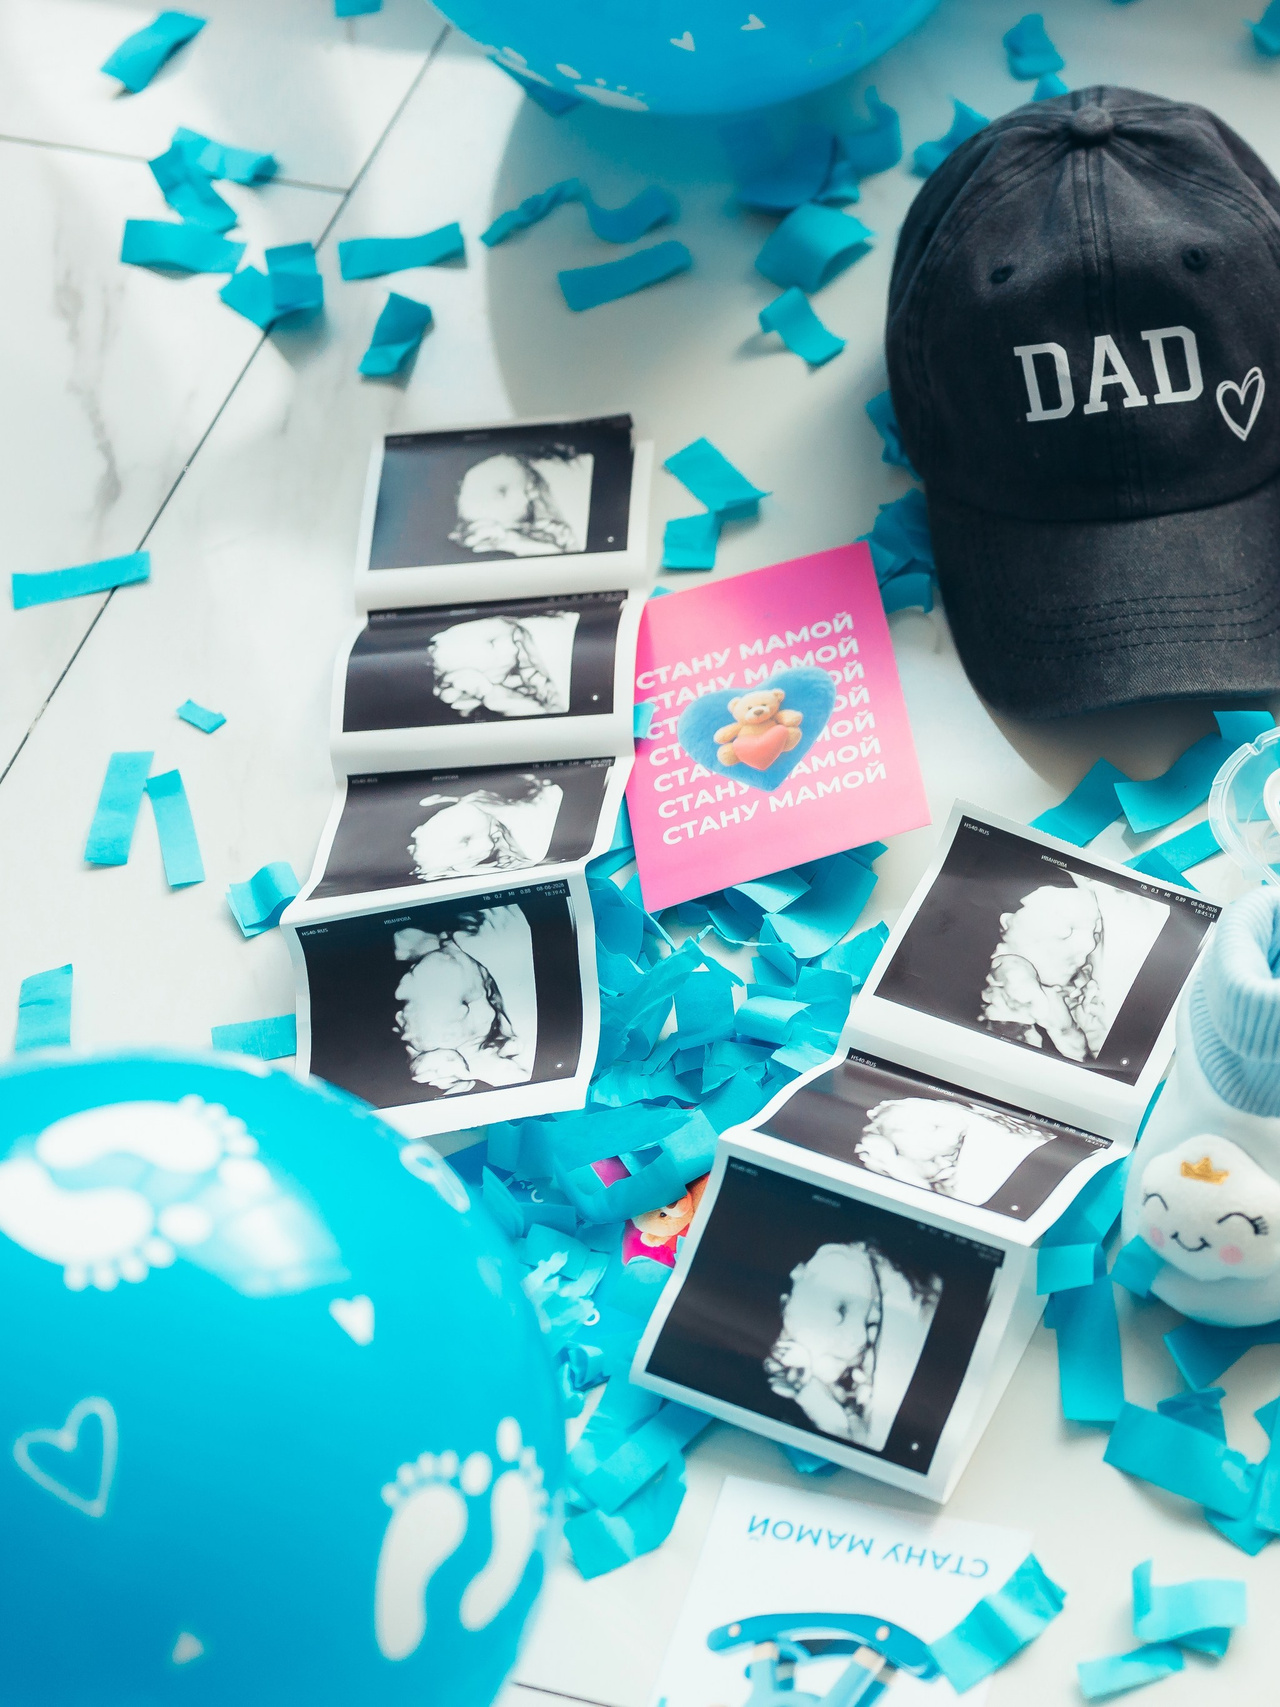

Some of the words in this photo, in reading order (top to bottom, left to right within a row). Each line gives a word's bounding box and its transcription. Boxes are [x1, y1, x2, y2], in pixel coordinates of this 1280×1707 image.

[1013, 325, 1204, 422] DAD
[636, 647, 731, 690] СТАНУ
[739, 612, 854, 660] МАМОЙ
[653, 766, 719, 793] СТА
[785, 735, 882, 780] АМОЙ
[662, 800, 760, 845] СТАНУ
[769, 760, 888, 813] МАМОЙ
[747, 1514, 875, 1557] МАМОЙ
[882, 1542, 990, 1579] СТАНУ
